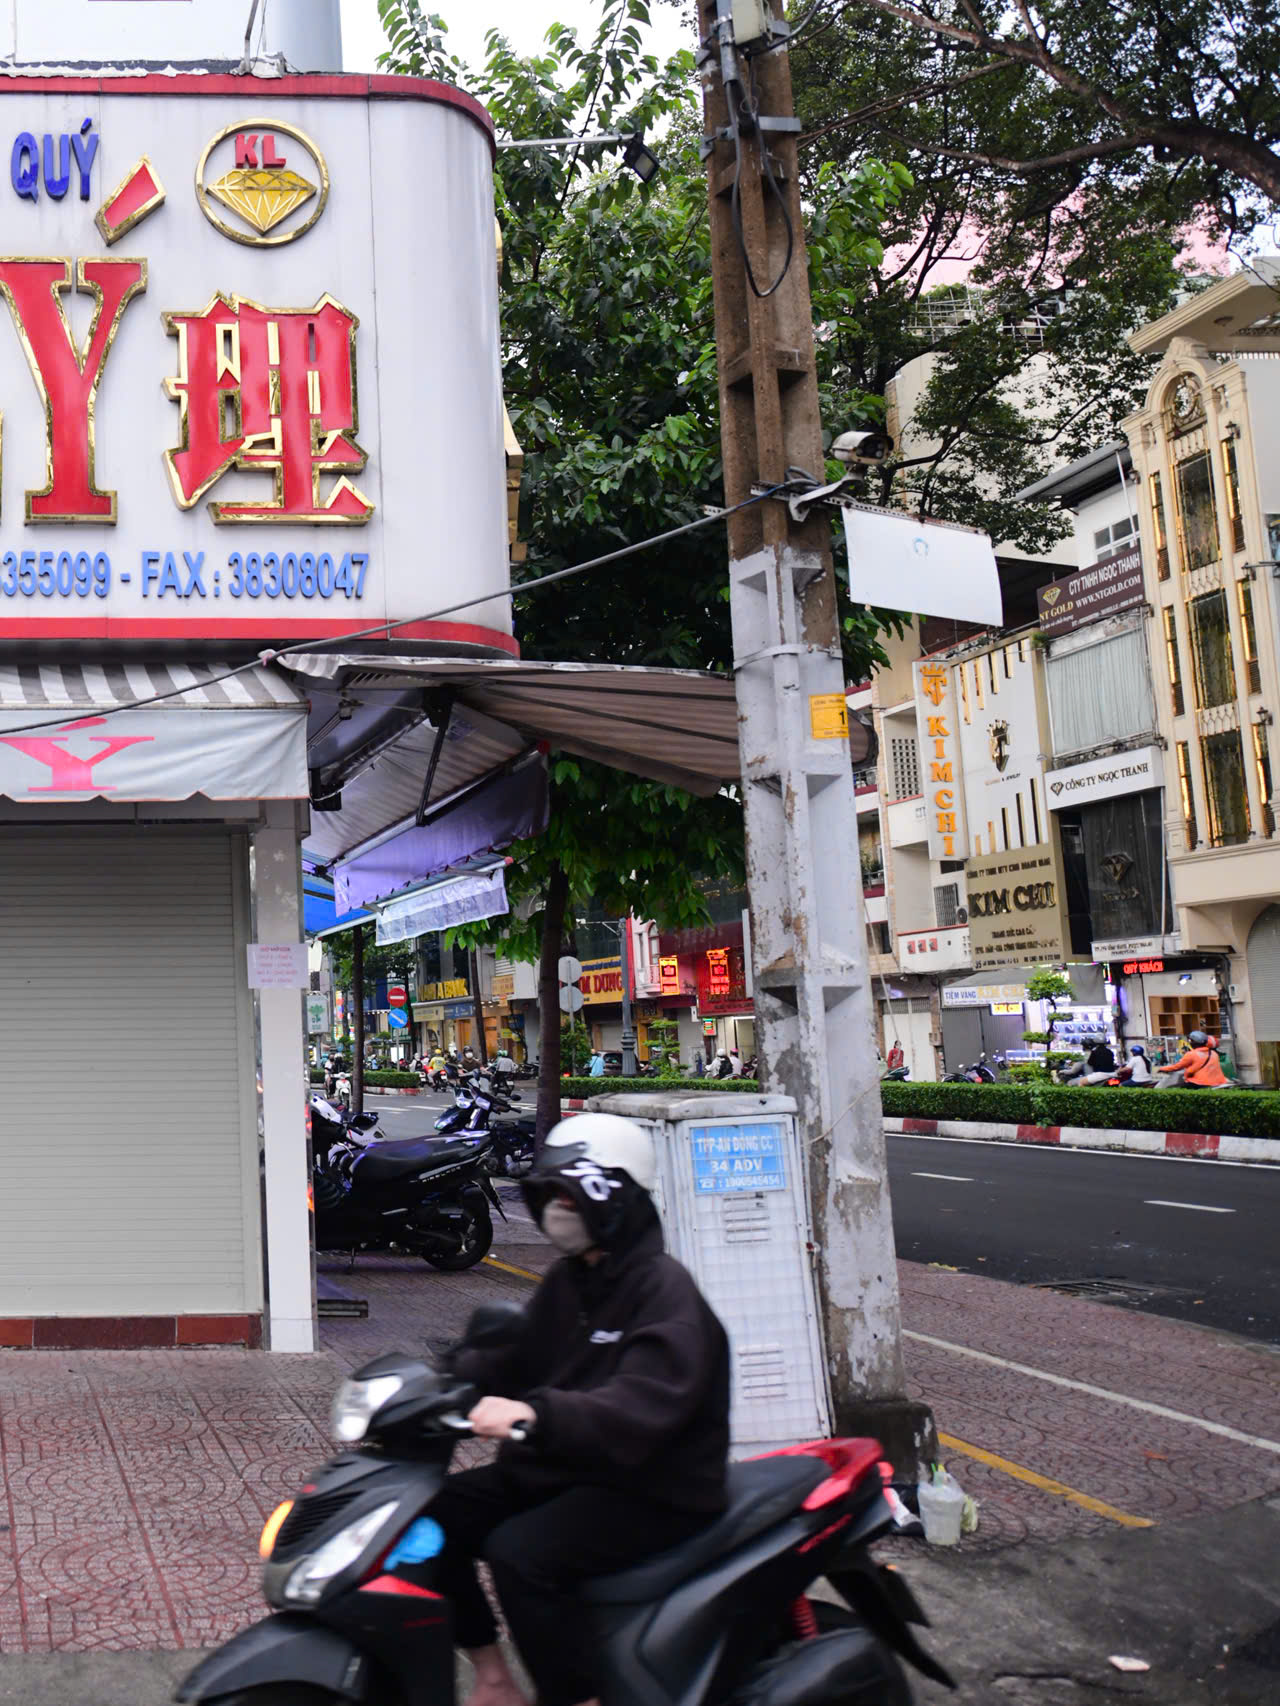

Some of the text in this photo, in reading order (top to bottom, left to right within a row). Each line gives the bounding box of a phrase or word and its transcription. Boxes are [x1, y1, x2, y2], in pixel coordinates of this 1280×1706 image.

[11, 117, 99, 204] QUÝ
[235, 134, 287, 169] KL
[160, 290, 377, 528] 理
[227, 550, 371, 600] 38308047
[710, 1158, 763, 1173] 34 ADV
